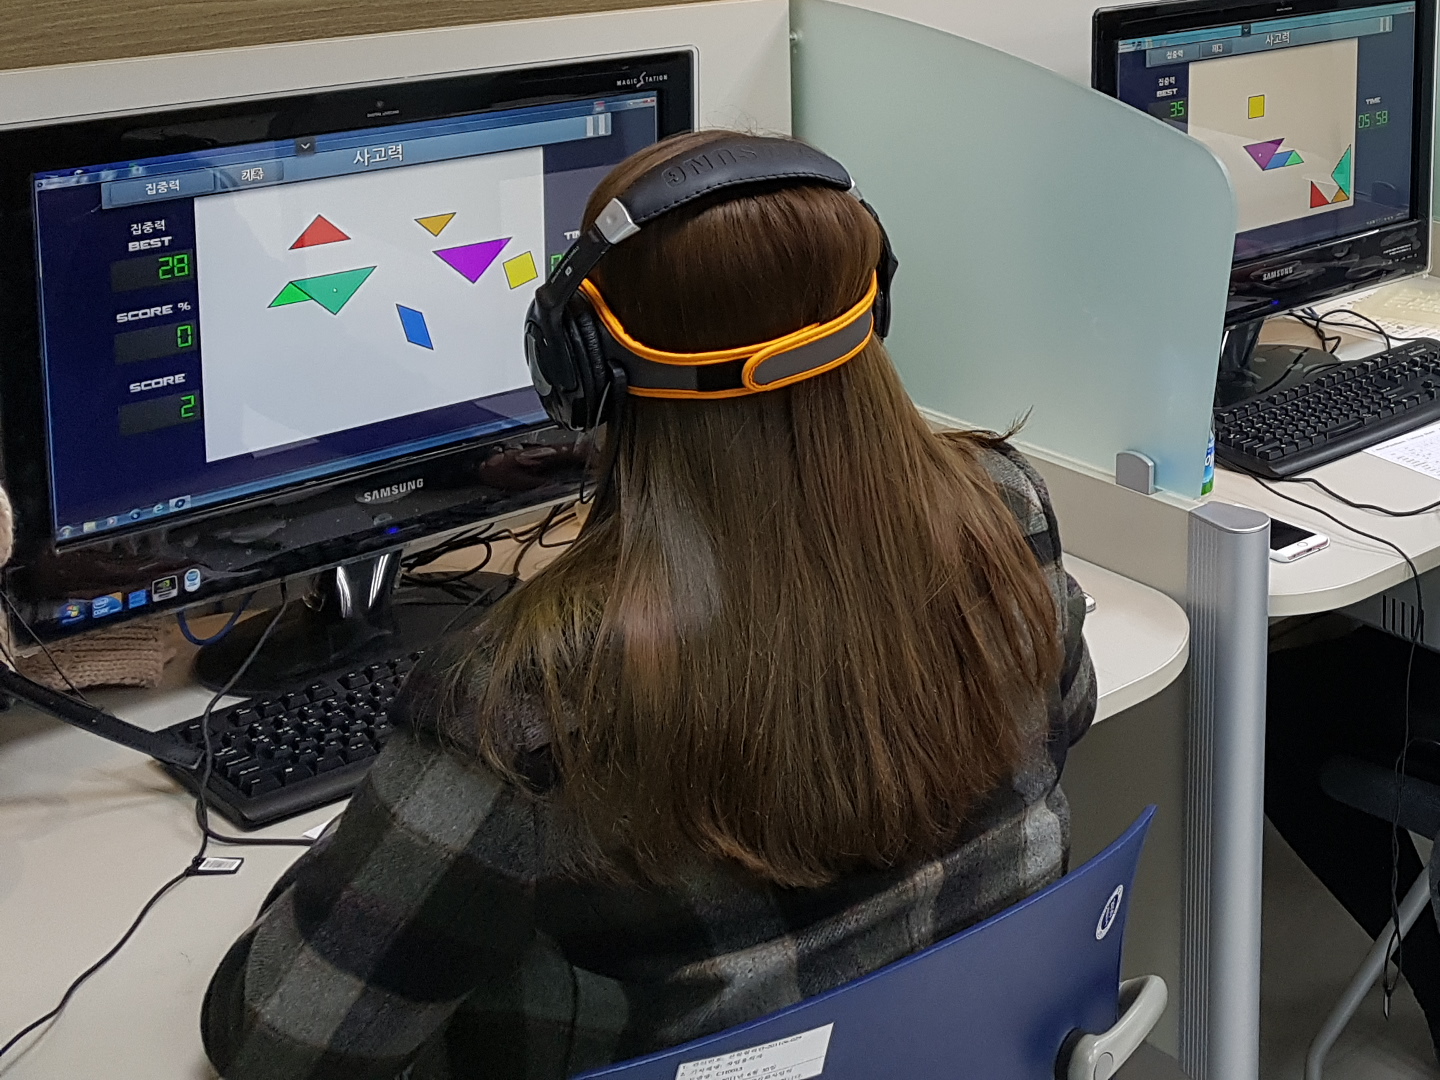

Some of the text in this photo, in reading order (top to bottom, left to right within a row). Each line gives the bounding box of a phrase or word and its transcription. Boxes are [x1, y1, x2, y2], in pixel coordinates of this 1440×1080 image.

[1265, 31, 1291, 47] 사고력
[616, 77, 638, 87] MAGIC
[1156, 88, 1178, 98] BEST
[1170, 101, 1185, 118] 35
[353, 143, 404, 167] 사고력
[146, 179, 180, 195] 집중력
[130, 219, 166, 235] 집중력
[128, 236, 173, 252] BEST
[158, 254, 189, 280] 28
[1262, 266, 1293, 281] SAMSUNG
[116, 302, 191, 323] SCORE %
[177, 325, 192, 348] 0
[129, 373, 186, 393] SCORE
[181, 394, 195, 418] 2
[364, 478, 424, 502] SAMSUNG
